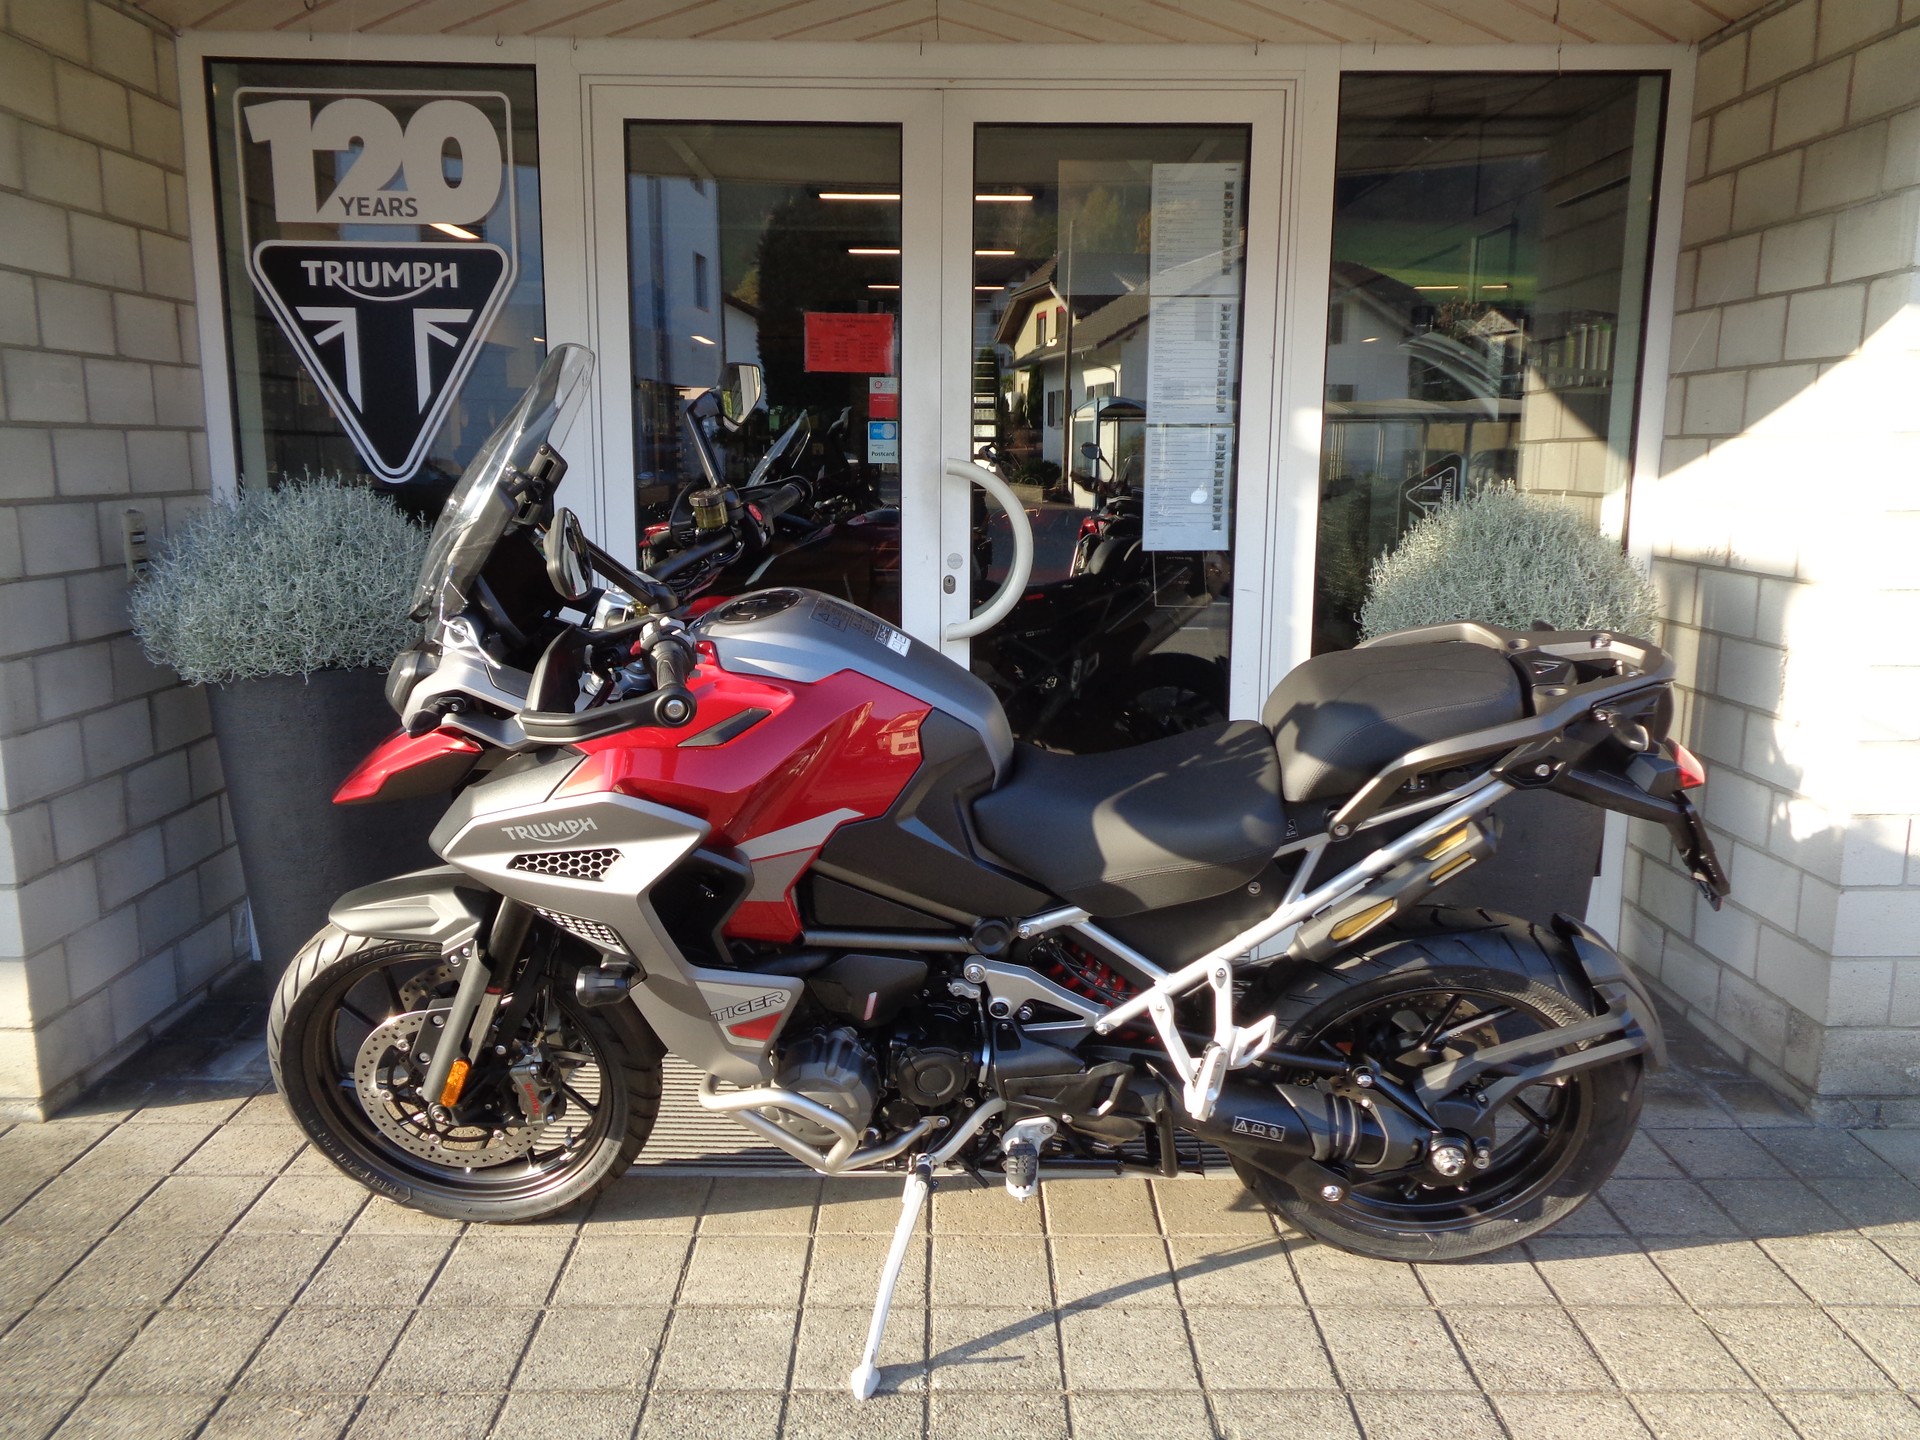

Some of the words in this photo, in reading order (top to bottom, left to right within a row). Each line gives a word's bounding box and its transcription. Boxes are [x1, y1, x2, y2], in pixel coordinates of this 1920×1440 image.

[243, 98, 502, 224] 120
[338, 196, 418, 217] YEARS
[301, 260, 458, 301] TRIUMPH
[501, 817, 598, 842] TRIUMPH
[709, 990, 785, 1021] TIGER
